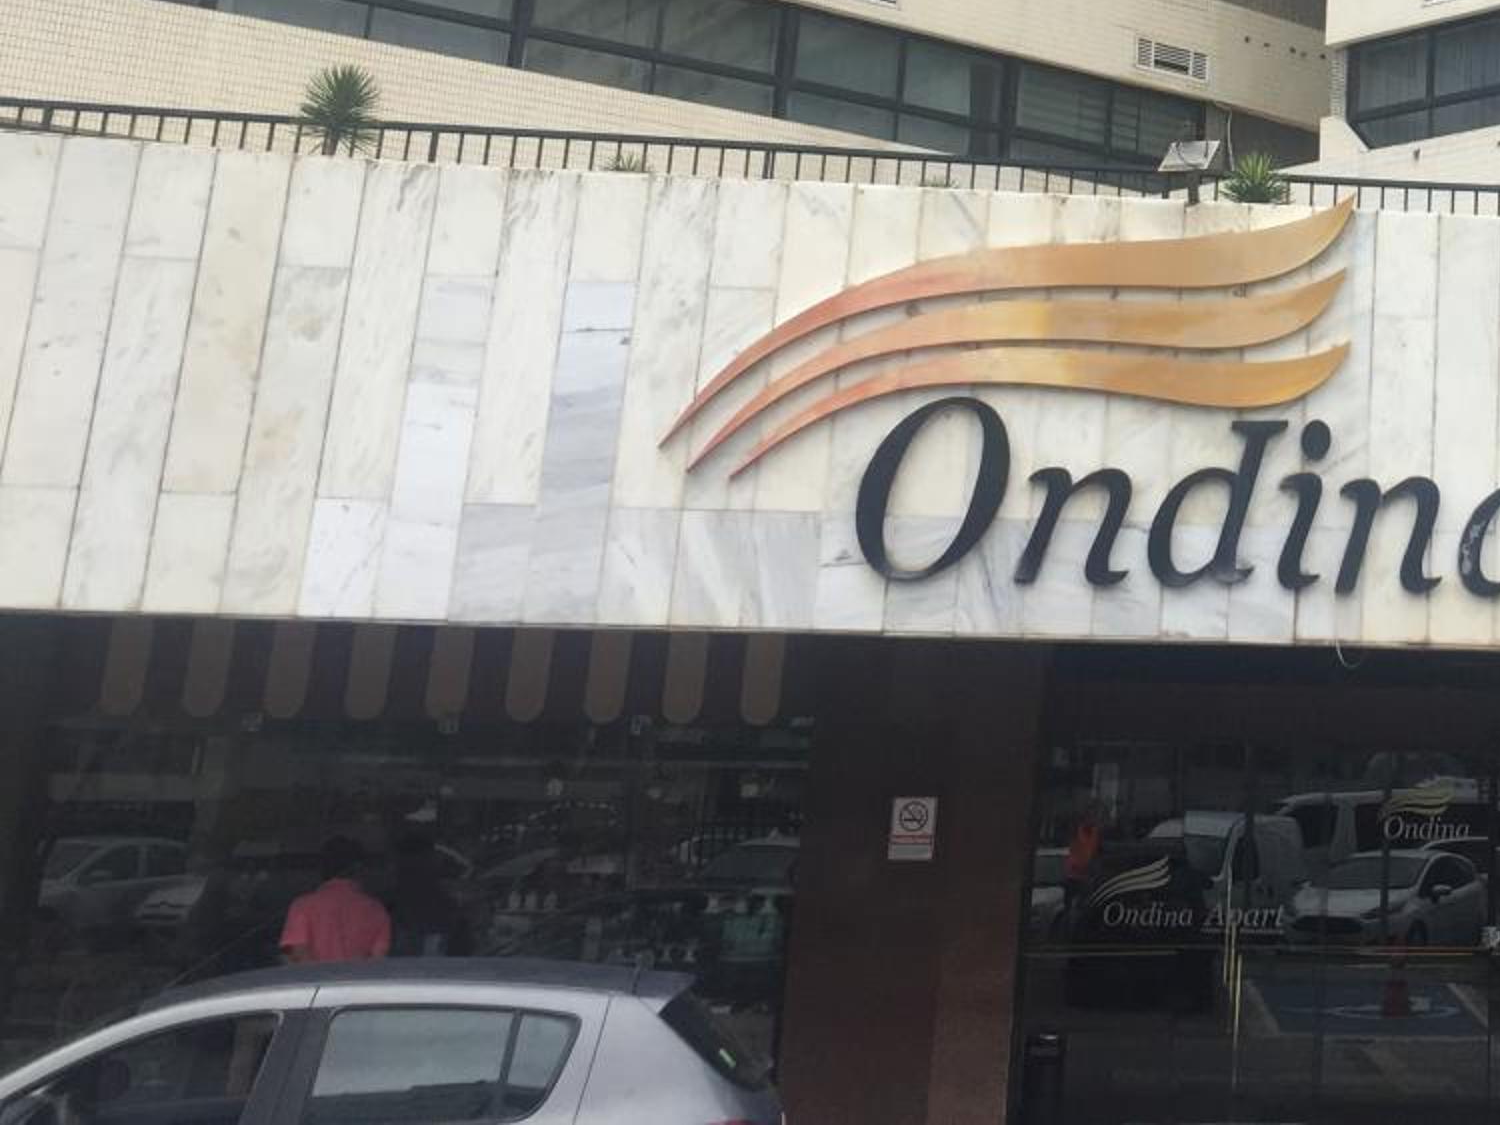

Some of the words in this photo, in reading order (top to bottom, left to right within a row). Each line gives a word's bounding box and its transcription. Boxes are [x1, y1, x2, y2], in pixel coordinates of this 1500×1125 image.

[1383, 815, 1471, 840] Ondina
[1103, 901, 1193, 928] Ondina
[1202, 902, 1285, 929] Apart
